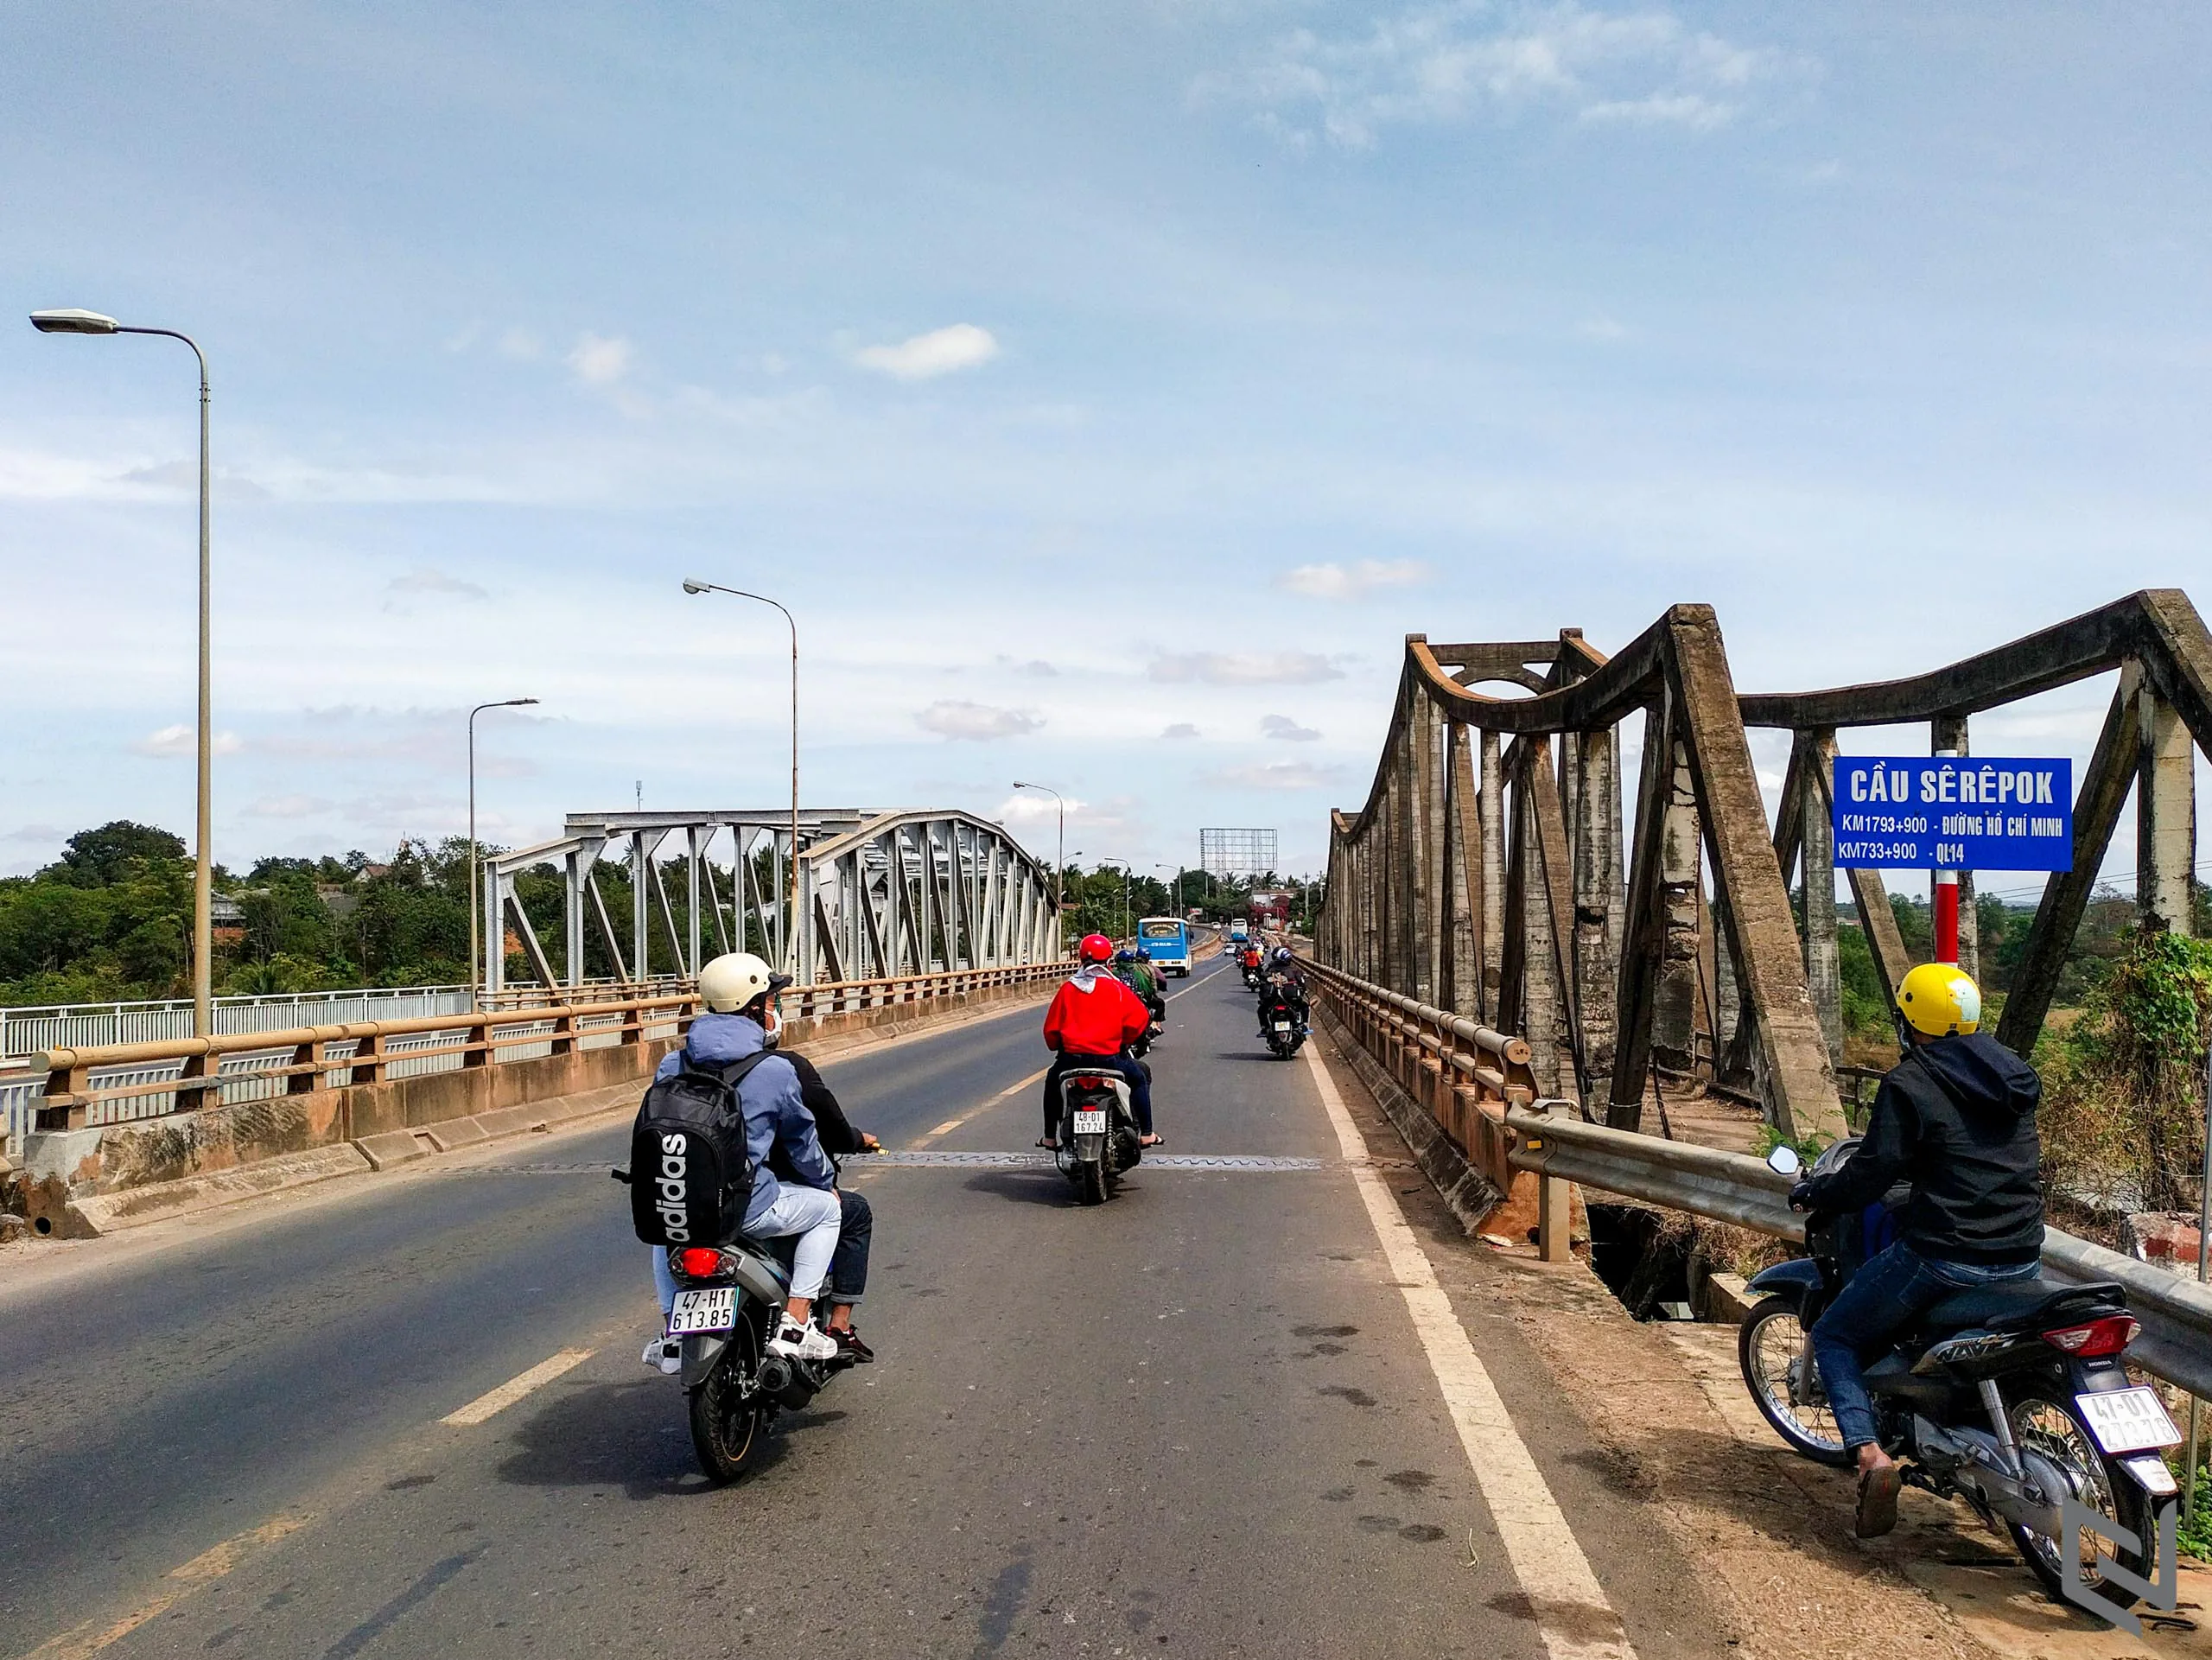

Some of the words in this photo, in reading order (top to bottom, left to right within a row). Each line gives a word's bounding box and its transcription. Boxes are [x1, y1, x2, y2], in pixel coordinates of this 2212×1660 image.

[1851, 761, 1909, 802] CẦU
[1920, 765, 2054, 805] SÊRÊPOK
[1842, 814, 1928, 834] KM1793+900
[1942, 811, 1982, 836] ĐƯỜNG
[1985, 810, 2002, 836] HỒ
[2007, 813, 2027, 836] CHÍ
[2031, 817, 2063, 837] MINH
[1838, 842, 1916, 860] KM733+900
[1936, 843, 1964, 864] QL14
[1078, 1112, 1100, 1122] 48-D1
[655, 1134, 690, 1242] adidas
[682, 1289, 727, 1310] 47-H1
[672, 1308, 732, 1330] 613.85
